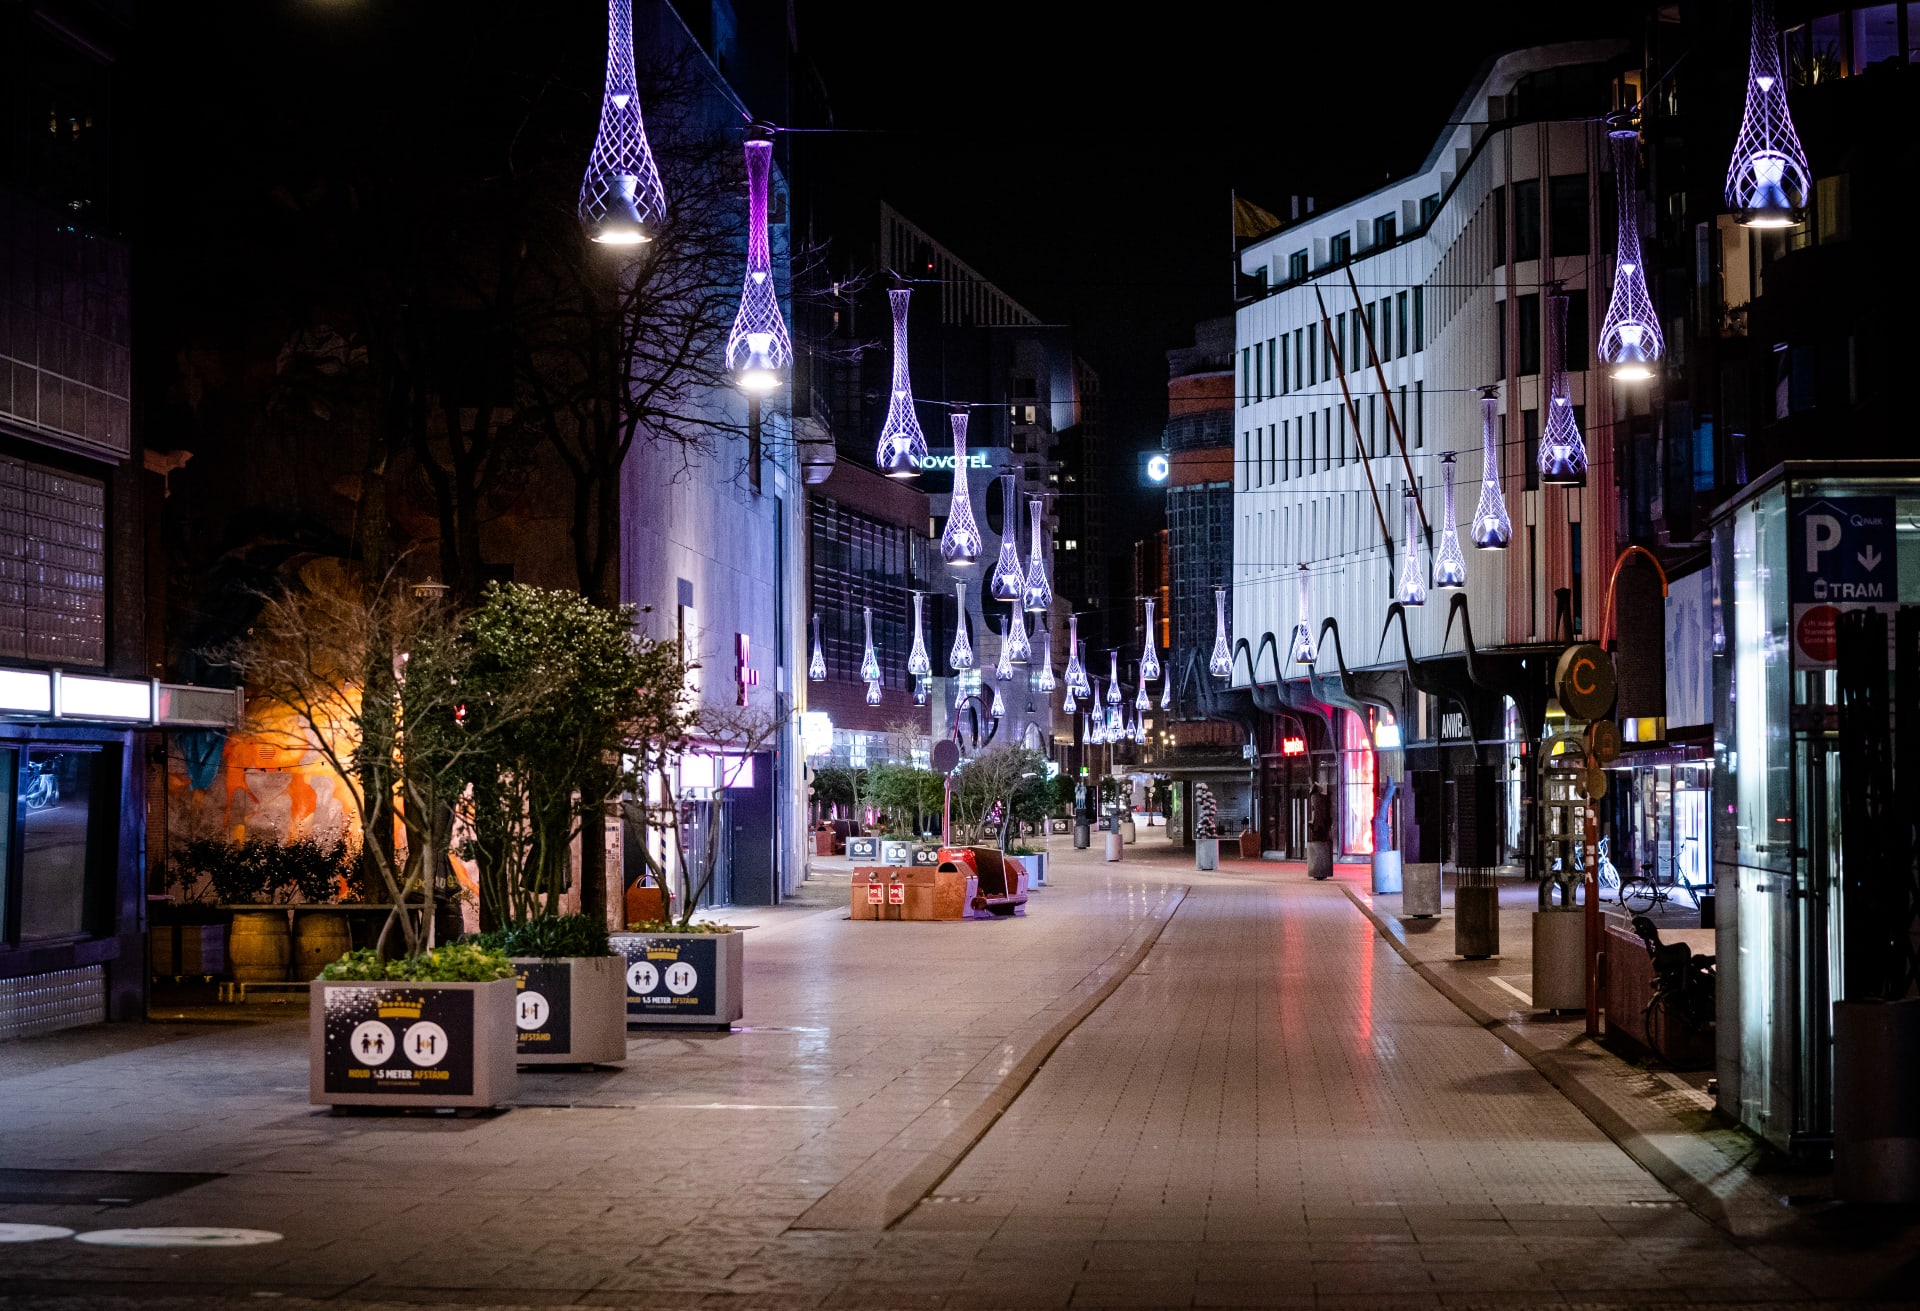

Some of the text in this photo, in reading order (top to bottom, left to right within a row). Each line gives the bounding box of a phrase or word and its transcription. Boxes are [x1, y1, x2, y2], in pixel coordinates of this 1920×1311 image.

[1806, 514, 1842, 572] P
[1830, 583, 1883, 597] TRAM
[1441, 712, 1463, 739] ANWB
[385, 1069, 412, 1079] METER
